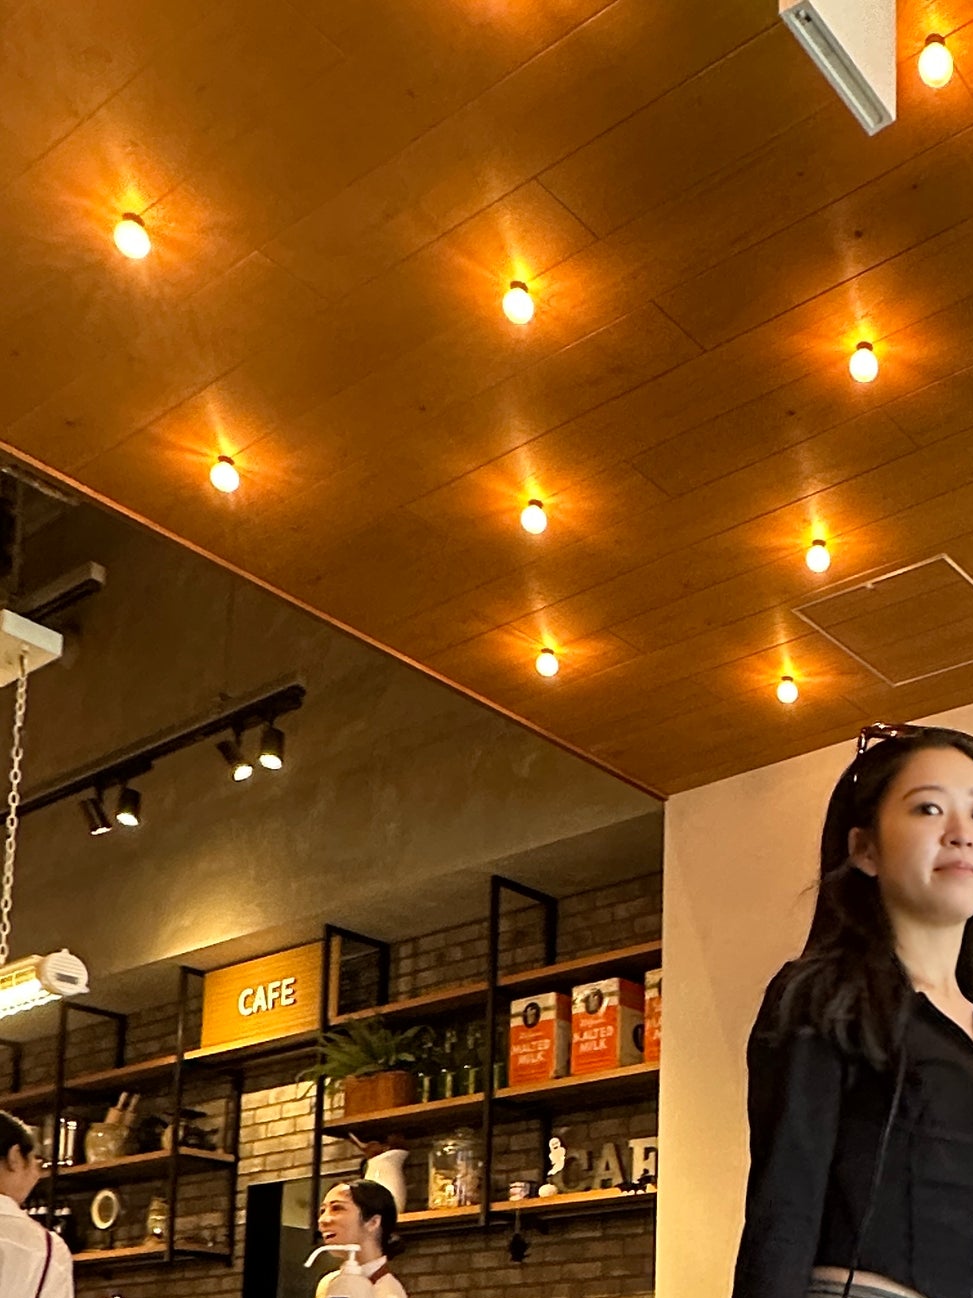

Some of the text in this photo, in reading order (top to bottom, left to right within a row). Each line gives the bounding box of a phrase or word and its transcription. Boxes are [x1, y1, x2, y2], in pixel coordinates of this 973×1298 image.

[238, 977, 295, 1016] CAFE
[572, 1025, 615, 1043] MALTED
[579, 1039, 608, 1053] MILK
